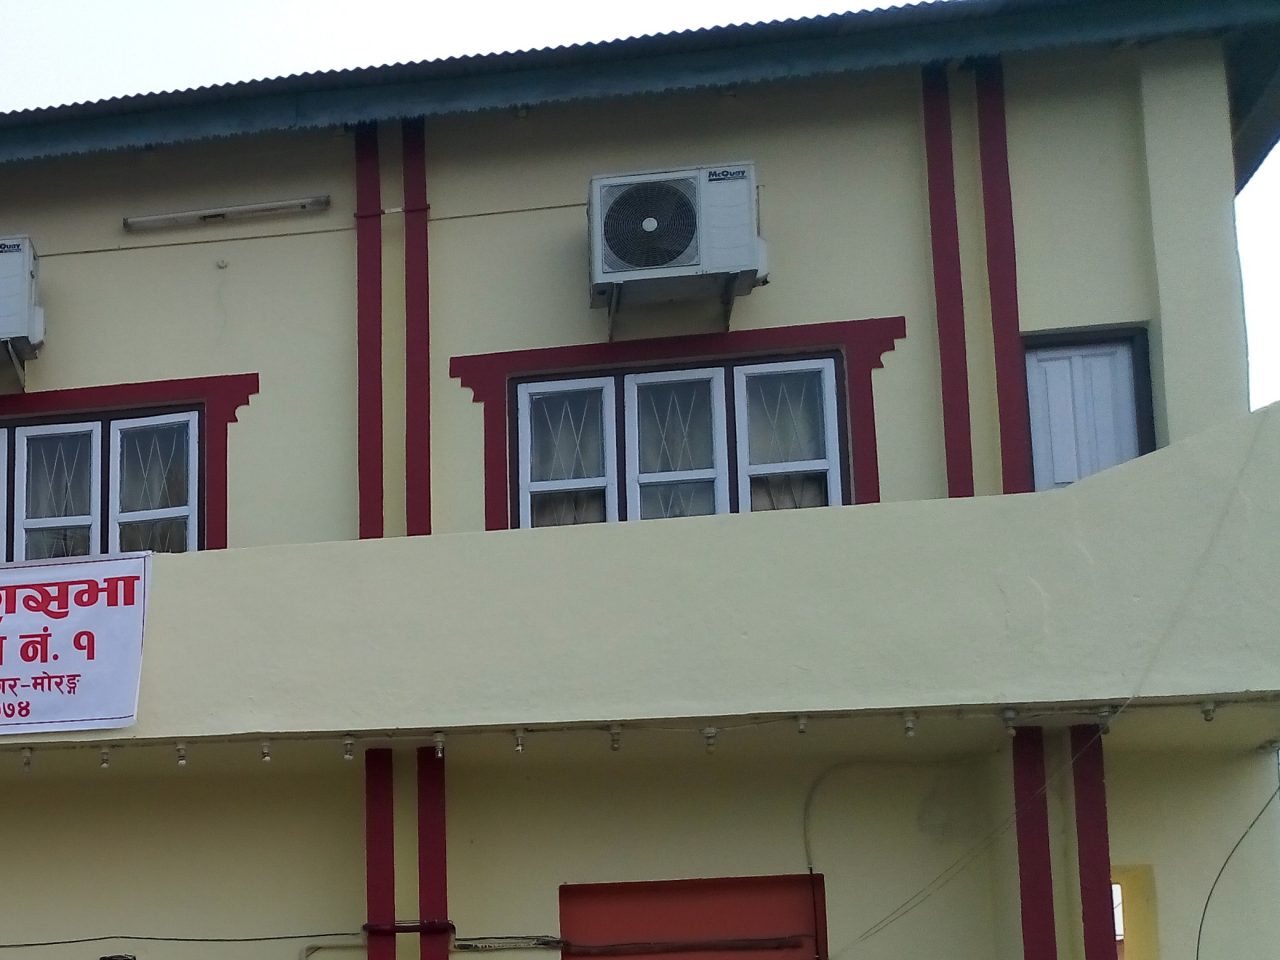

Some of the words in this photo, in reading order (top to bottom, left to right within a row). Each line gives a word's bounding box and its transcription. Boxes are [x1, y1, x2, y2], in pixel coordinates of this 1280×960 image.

[708, 170, 746, 178] McQuay
[19, 626, 59, 664] नं.
[72, 630, 96, 661] १
